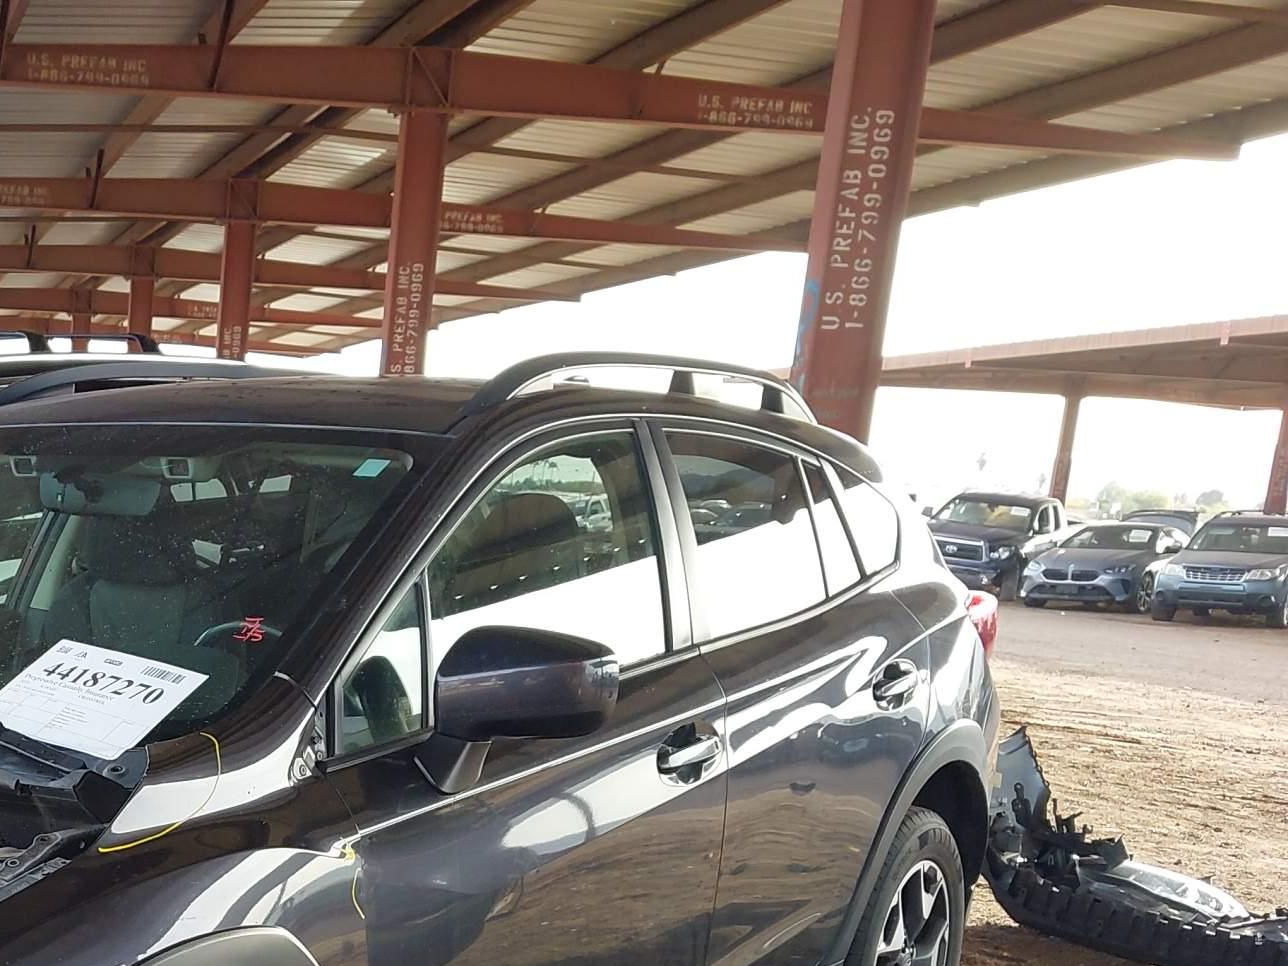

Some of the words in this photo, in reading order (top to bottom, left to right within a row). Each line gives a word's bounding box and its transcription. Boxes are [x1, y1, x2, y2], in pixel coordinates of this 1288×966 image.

[61, 54, 117, 69] PREFAB
[731, 95, 784, 112] PREFAB
[830, 168, 862, 268] PREFAB
[847, 106, 873, 155] INC.
[844, 108, 895, 330] 1-866-799-0969
[392, 296, 408, 353] PREFAB
[42, 662, 165, 705] 44187270
